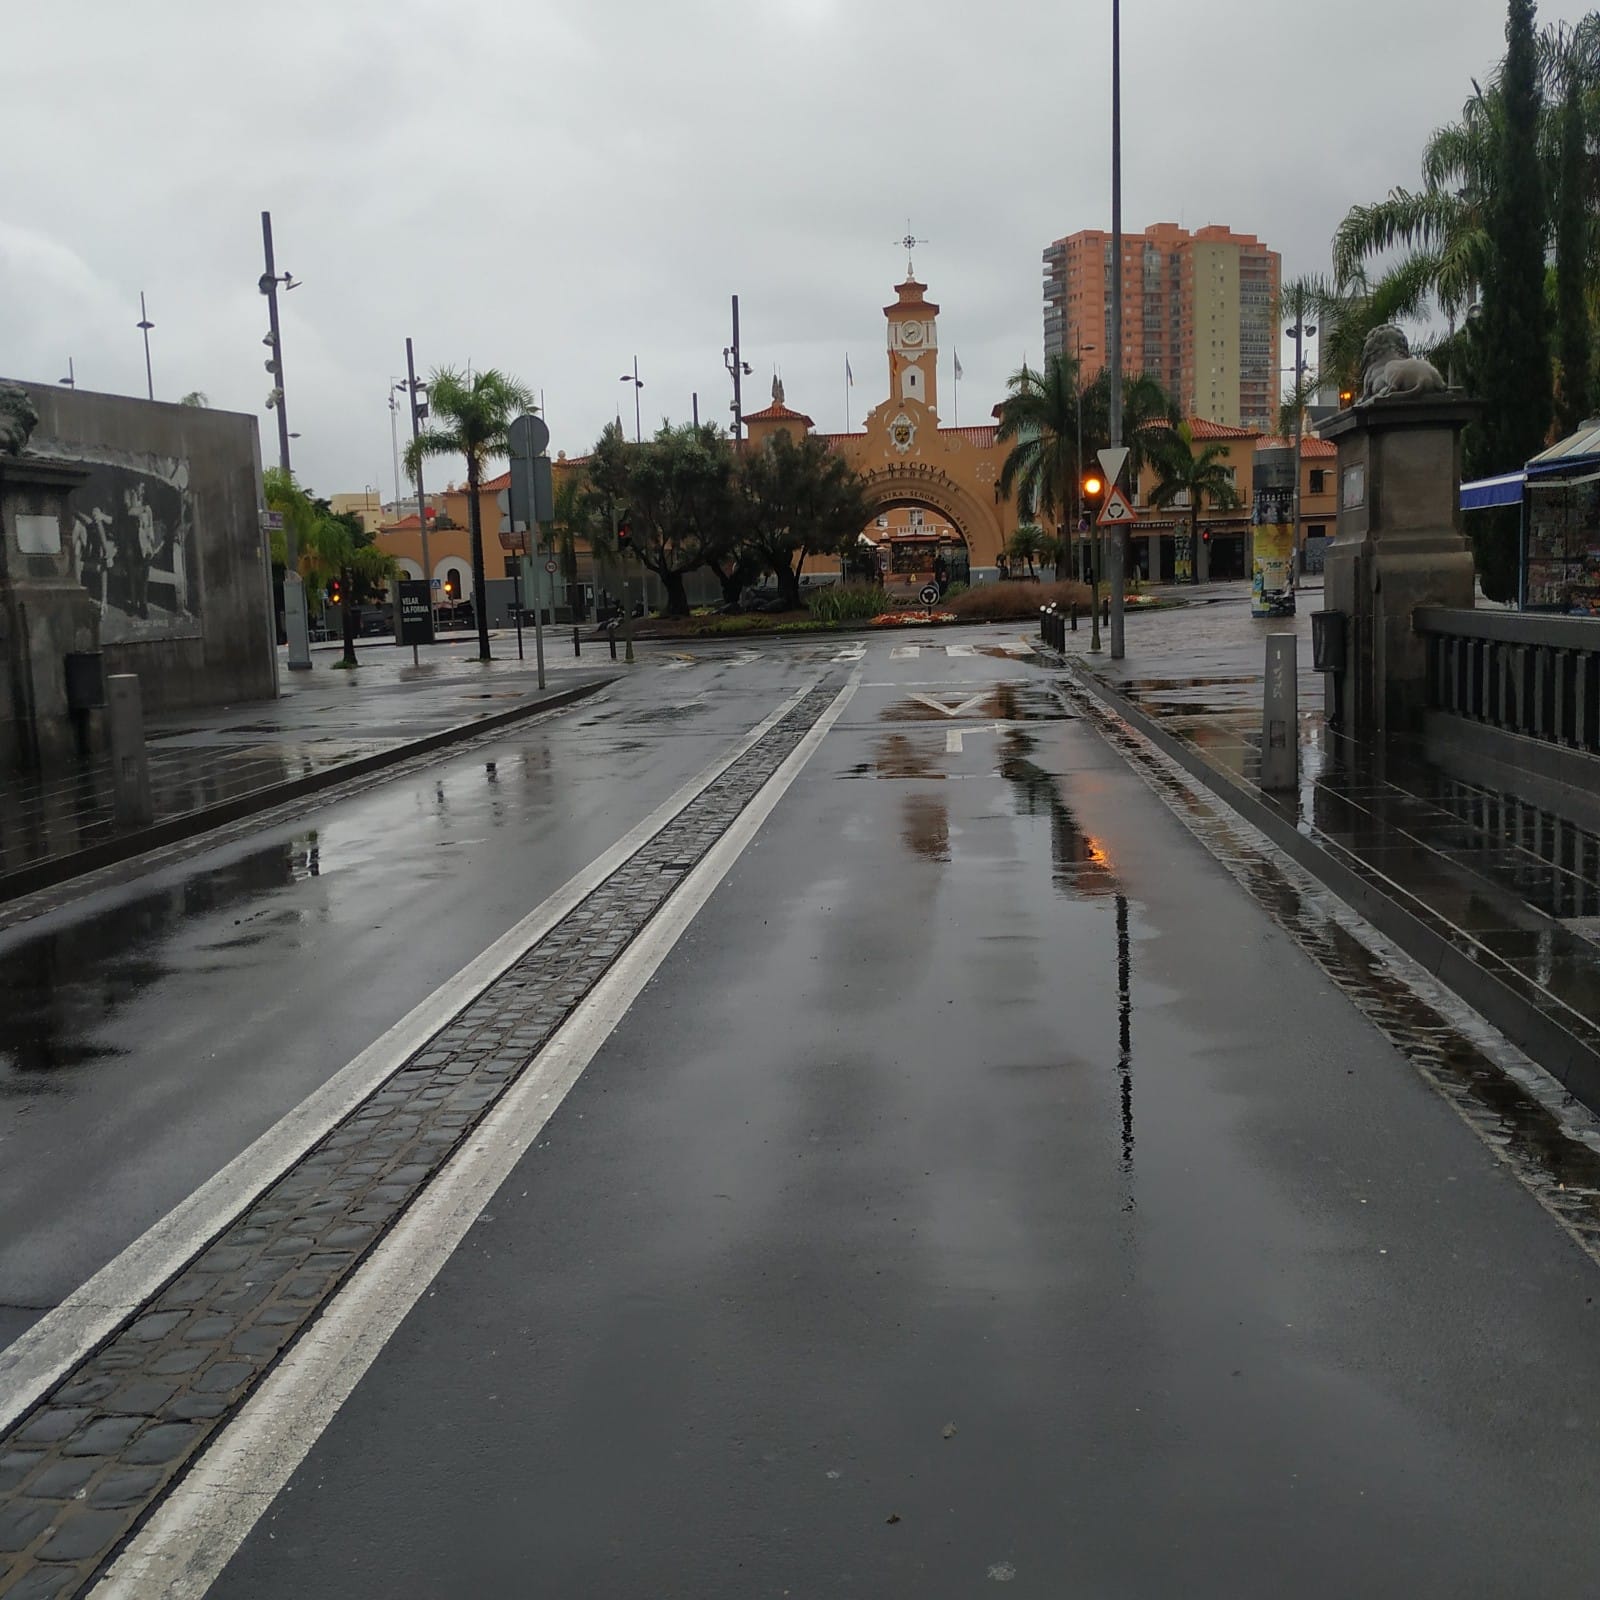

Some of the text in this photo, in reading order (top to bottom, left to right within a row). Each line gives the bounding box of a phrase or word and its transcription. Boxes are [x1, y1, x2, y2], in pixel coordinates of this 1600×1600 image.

[859, 462, 946, 482] LA RECOVA
[403, 605, 429, 613] LA FORMA
